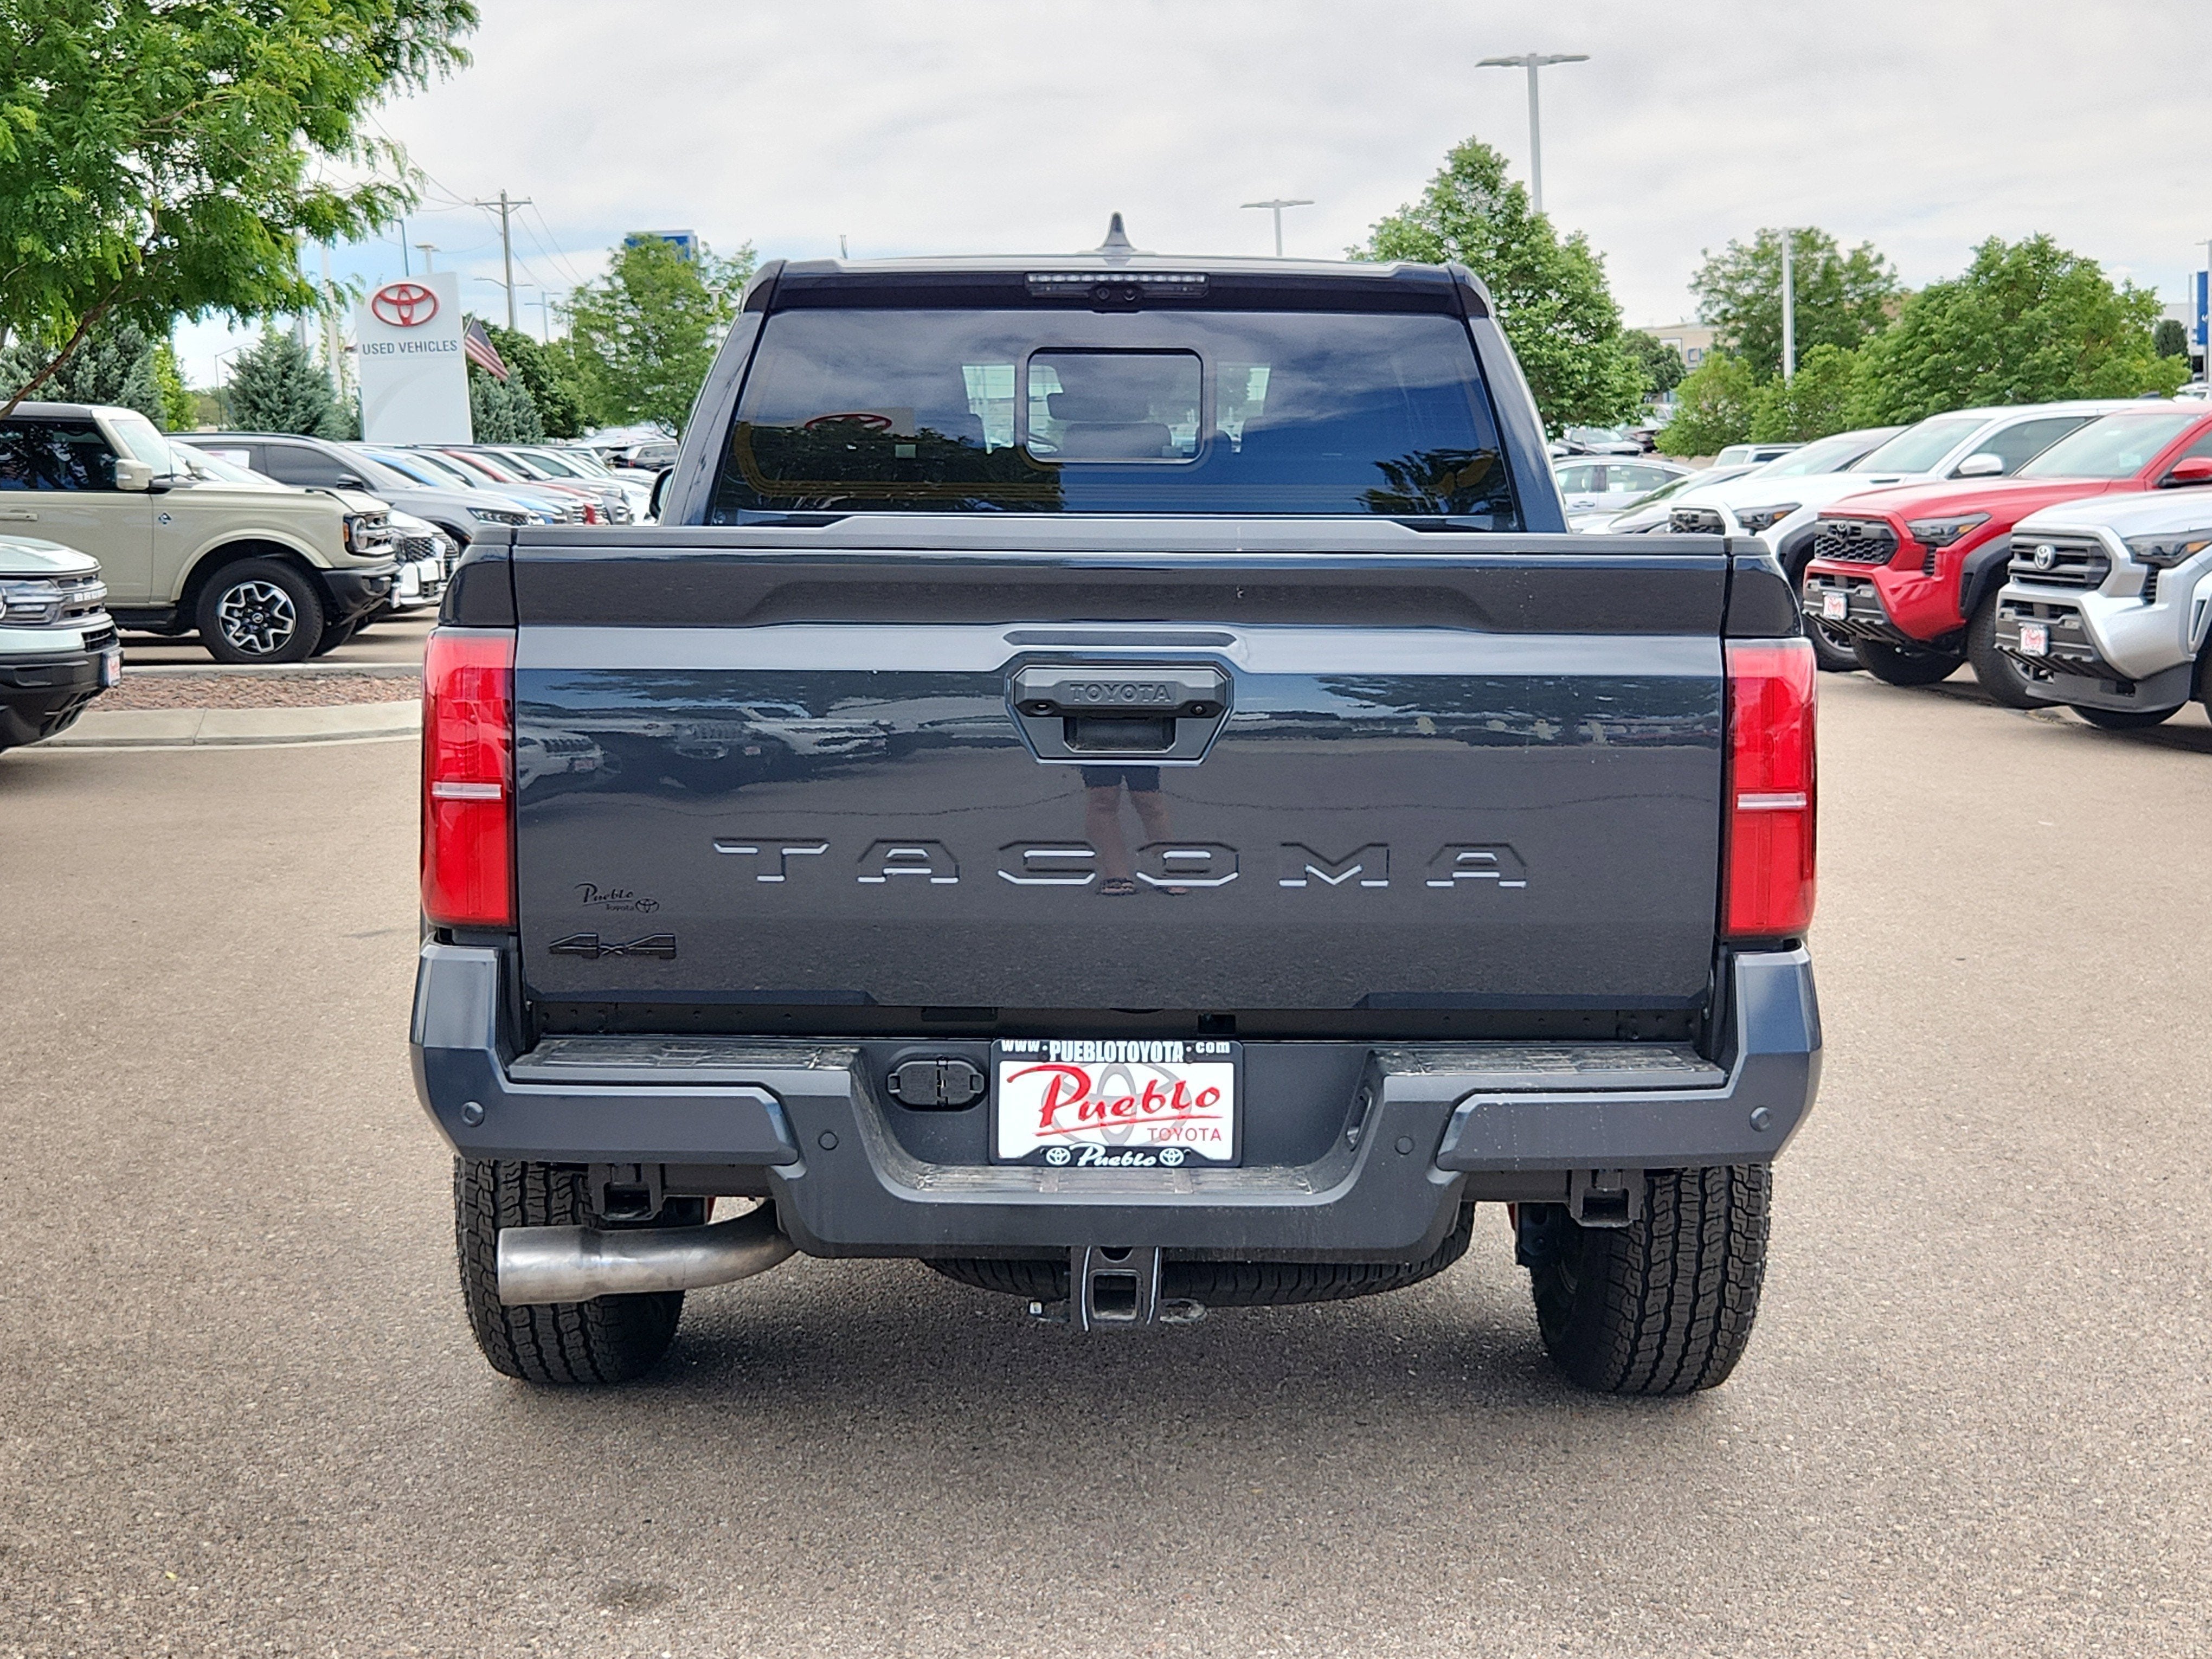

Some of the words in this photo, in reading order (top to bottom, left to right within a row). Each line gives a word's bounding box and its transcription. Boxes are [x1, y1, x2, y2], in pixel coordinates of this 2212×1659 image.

[362, 342, 395, 355] USED
[398, 339, 458, 354] VEHICLES
[1069, 684, 1171, 703] TOYOTA
[712, 838, 1528, 888] TACOMA
[574, 883, 633, 903] Pueblo
[1007, 1064, 1221, 1128] Pueblo
[1147, 1128, 1222, 1142] TOYOTA
[1070, 1143, 1157, 1167] Pueblo
